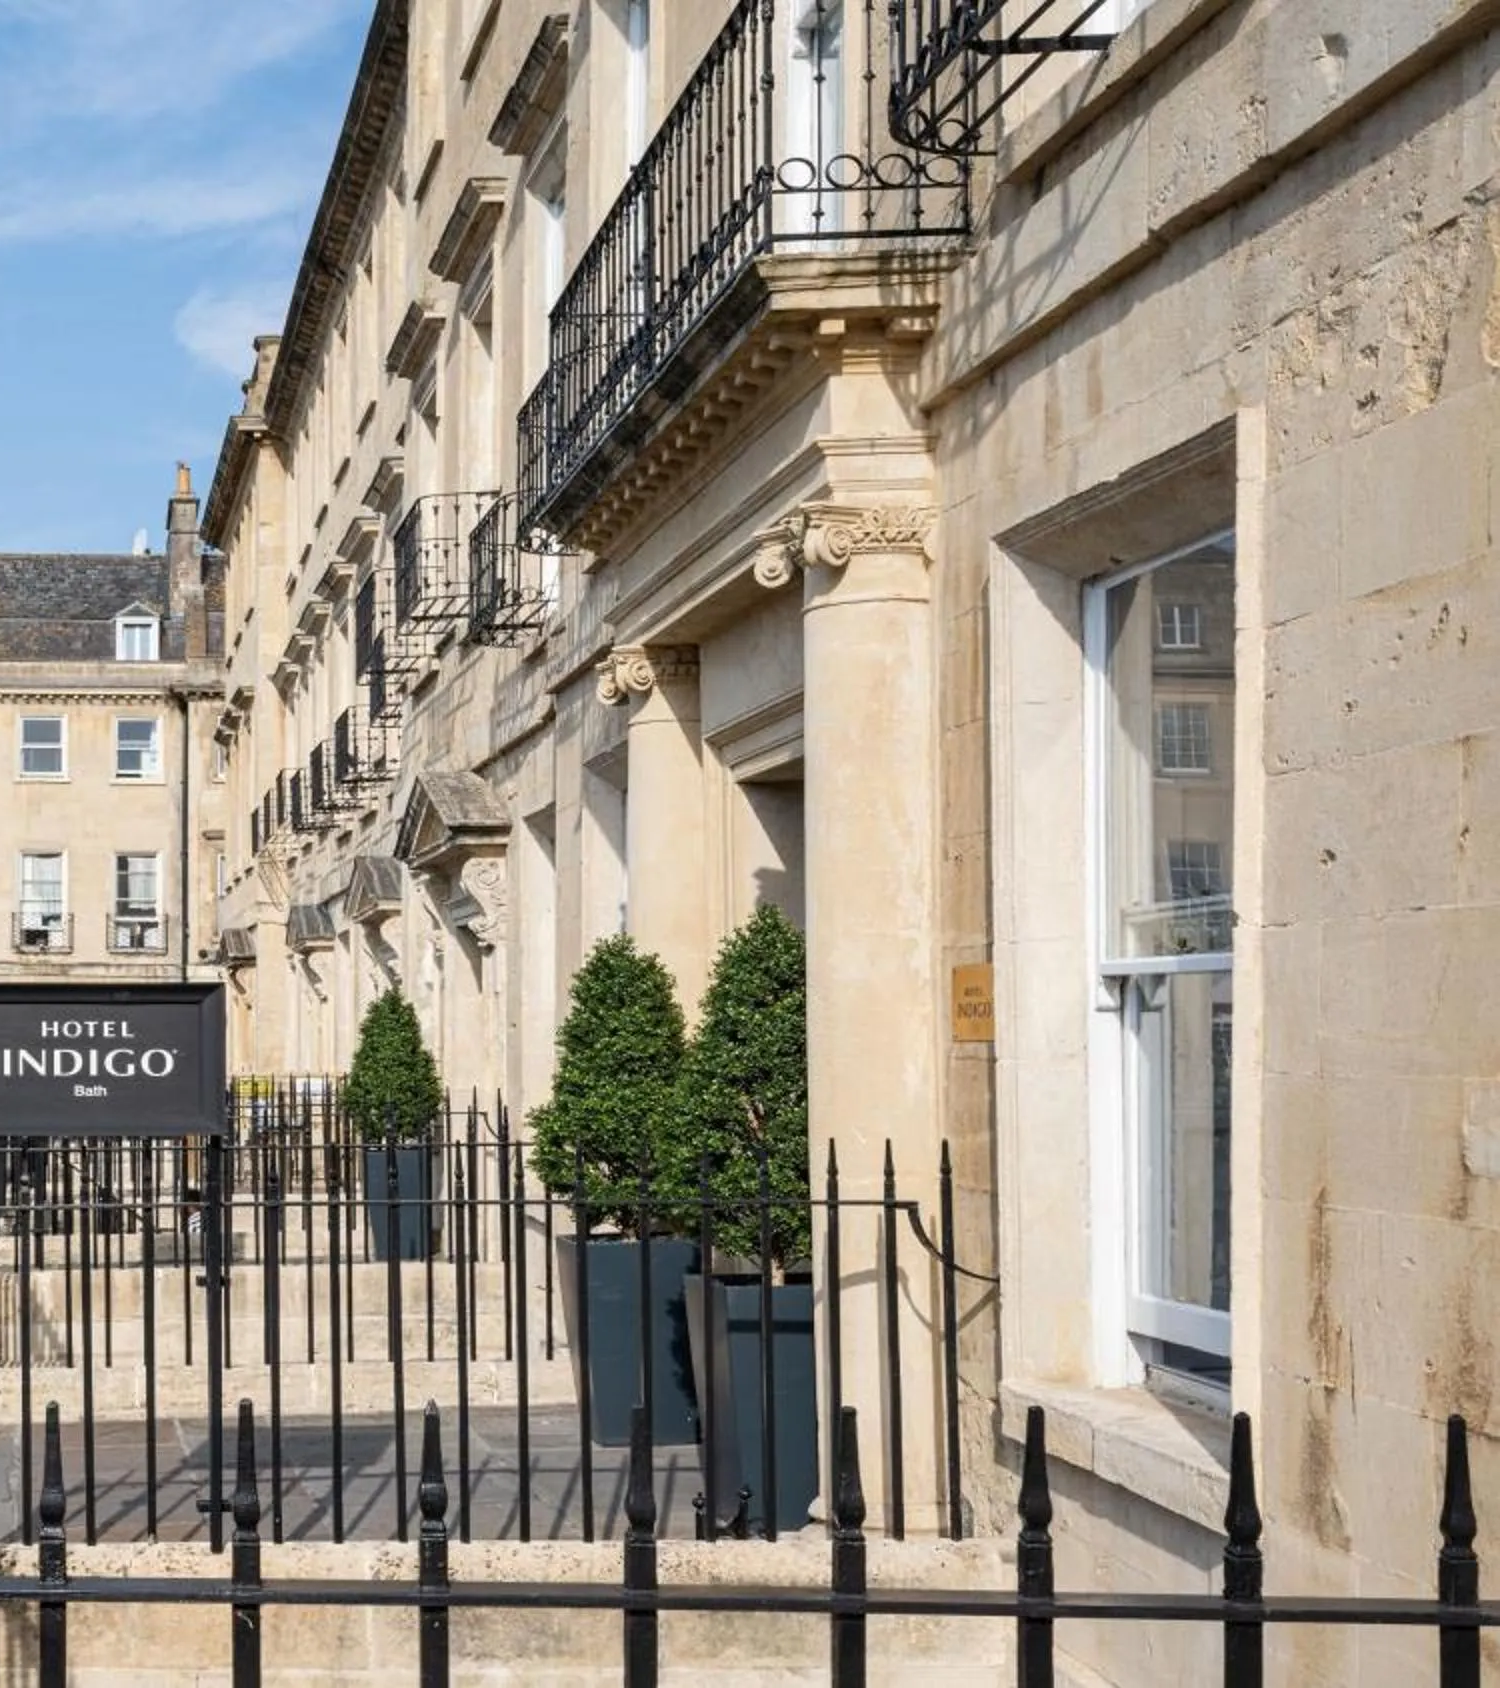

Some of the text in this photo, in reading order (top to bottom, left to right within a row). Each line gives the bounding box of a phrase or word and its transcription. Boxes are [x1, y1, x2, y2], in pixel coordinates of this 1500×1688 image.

[41, 1020, 135, 1038] HOTEL
[3, 1048, 174, 1077] INDIGO
[73, 1085, 108, 1097] Bath
